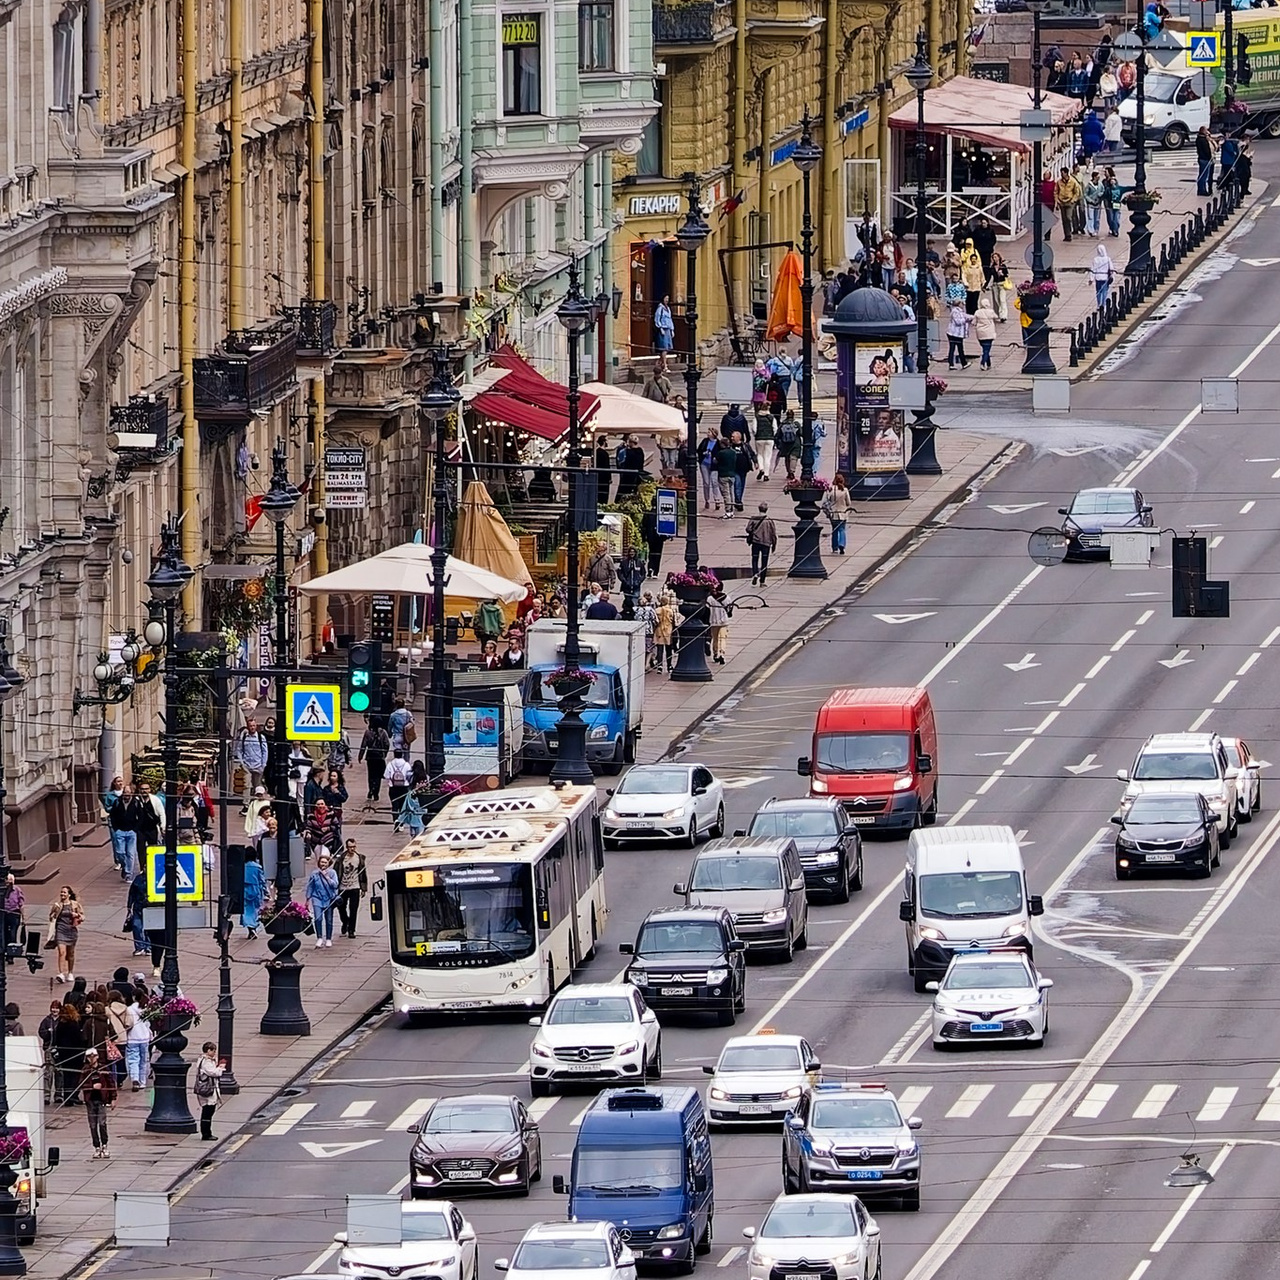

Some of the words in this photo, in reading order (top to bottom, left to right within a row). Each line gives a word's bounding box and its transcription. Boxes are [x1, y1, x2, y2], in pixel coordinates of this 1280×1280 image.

[630, 195, 681, 214] ПЕКАРНЯ
[860, 385, 890, 394] СОПЕР
[352, 671, 368, 686] 24
[416, 874, 424, 884] 3
[420, 943, 428, 956] 3
